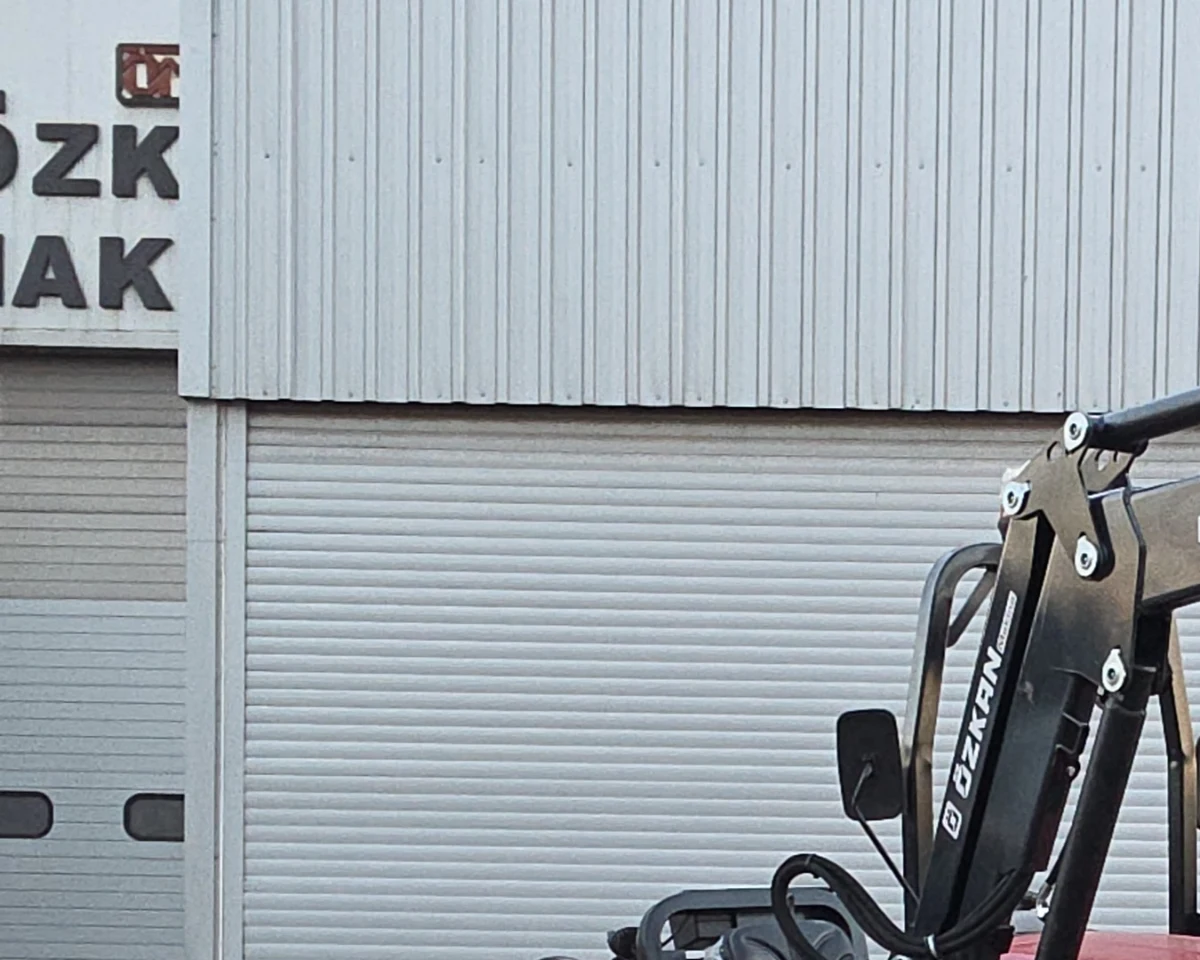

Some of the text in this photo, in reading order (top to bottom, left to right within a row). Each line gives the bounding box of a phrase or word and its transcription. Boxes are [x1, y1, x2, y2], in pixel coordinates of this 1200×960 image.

[0, 90, 179, 199] ZK
[0, 234, 174, 311] AK
[953, 646, 1003, 799] ÖZKAN
